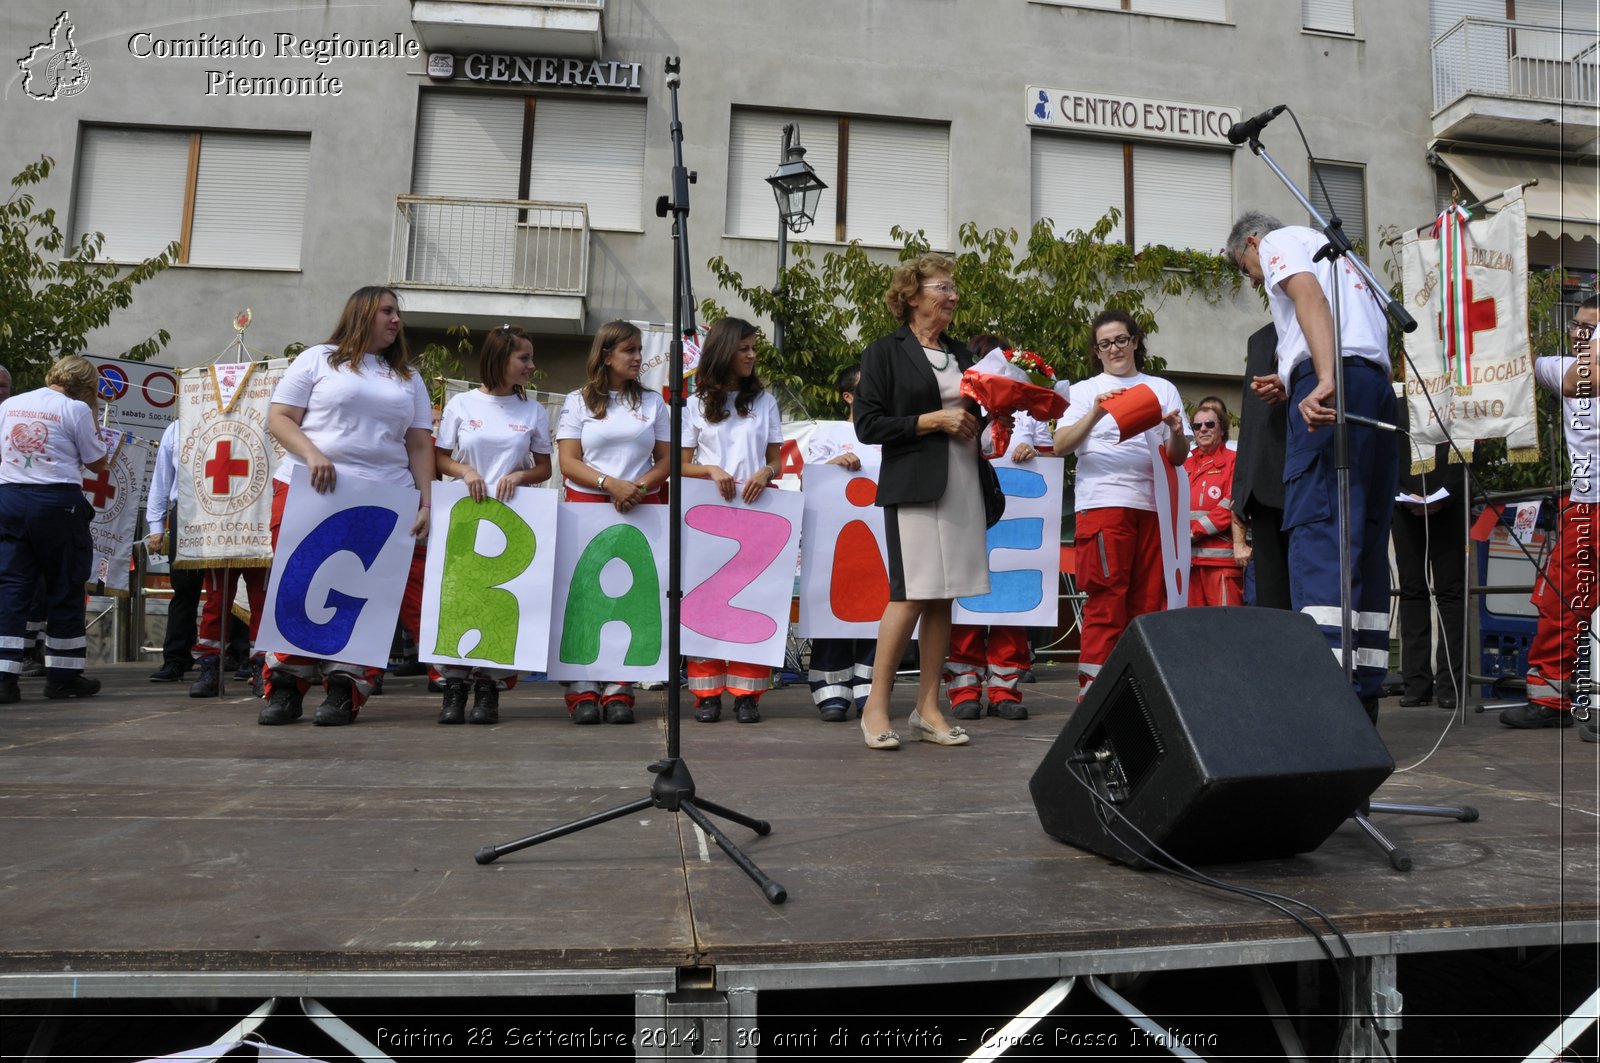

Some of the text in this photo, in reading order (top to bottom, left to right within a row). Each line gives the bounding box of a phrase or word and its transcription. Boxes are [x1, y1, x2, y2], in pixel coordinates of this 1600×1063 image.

[464, 53, 643, 89] GENERALI
[1060, 95, 1235, 138] CENTRO ESTETICO
[1472, 354, 1527, 384] LOCALE
[121, 410, 146, 419] sabato
[220, 522, 265, 533] LOCALE
